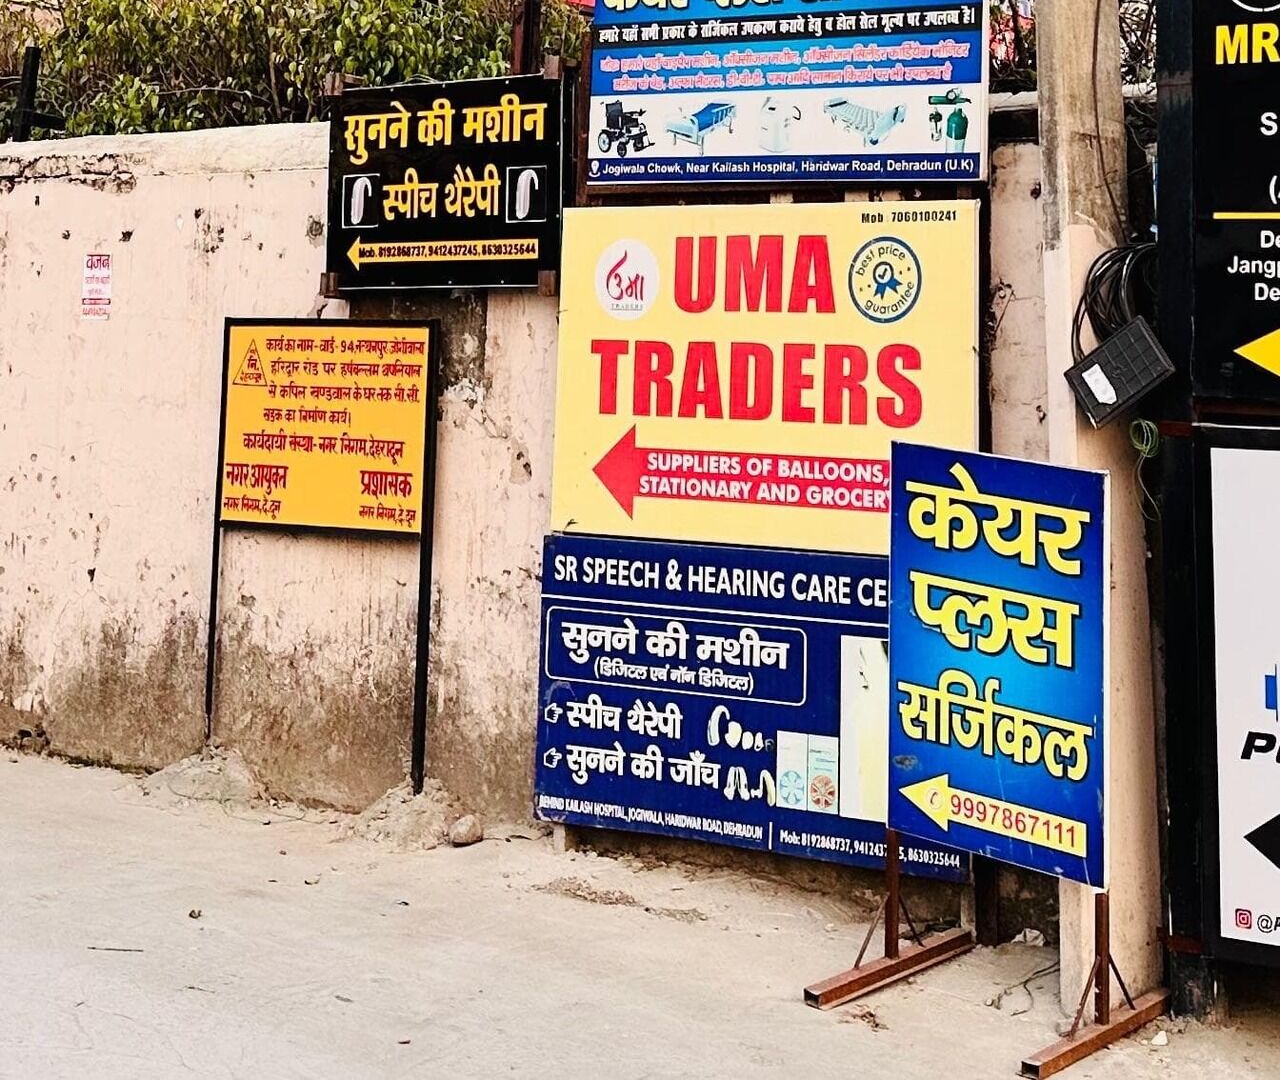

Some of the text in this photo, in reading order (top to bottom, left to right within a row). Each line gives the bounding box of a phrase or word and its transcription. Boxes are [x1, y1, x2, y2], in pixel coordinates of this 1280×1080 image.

[343, 93, 548, 165] सुनने की मशीन
[602, 158, 974, 175] Jogiwala Chowk, Near Haridwar Road, Dehradun (U.K)
[382, 167, 439, 220] स्पीच
[673, 235, 836, 314] UMA
[855, 244, 906, 277] best price
[864, 281, 915, 315] guarantee
[591, 339, 922, 429] TRADERS
[225, 462, 289, 496] नगर आयुक्त
[360, 469, 413, 499] प्रशासक
[647, 451, 774, 478] SUPPLIERS OF
[639, 478, 798, 503] STATIONARY AND
[905, 462, 1090, 575] केयर
[554, 555, 851, 605] SR SPEECH & HEARING CARE
[561, 618, 789, 670] सुनने की मशीन
[909, 570, 1079, 668] प्लस
[566, 694, 621, 732] स्पीच
[897, 668, 1092, 781] सर्जिकल
[565, 741, 721, 790] सुनने की जाँच
[949, 794, 1077, 849] 9997867111
